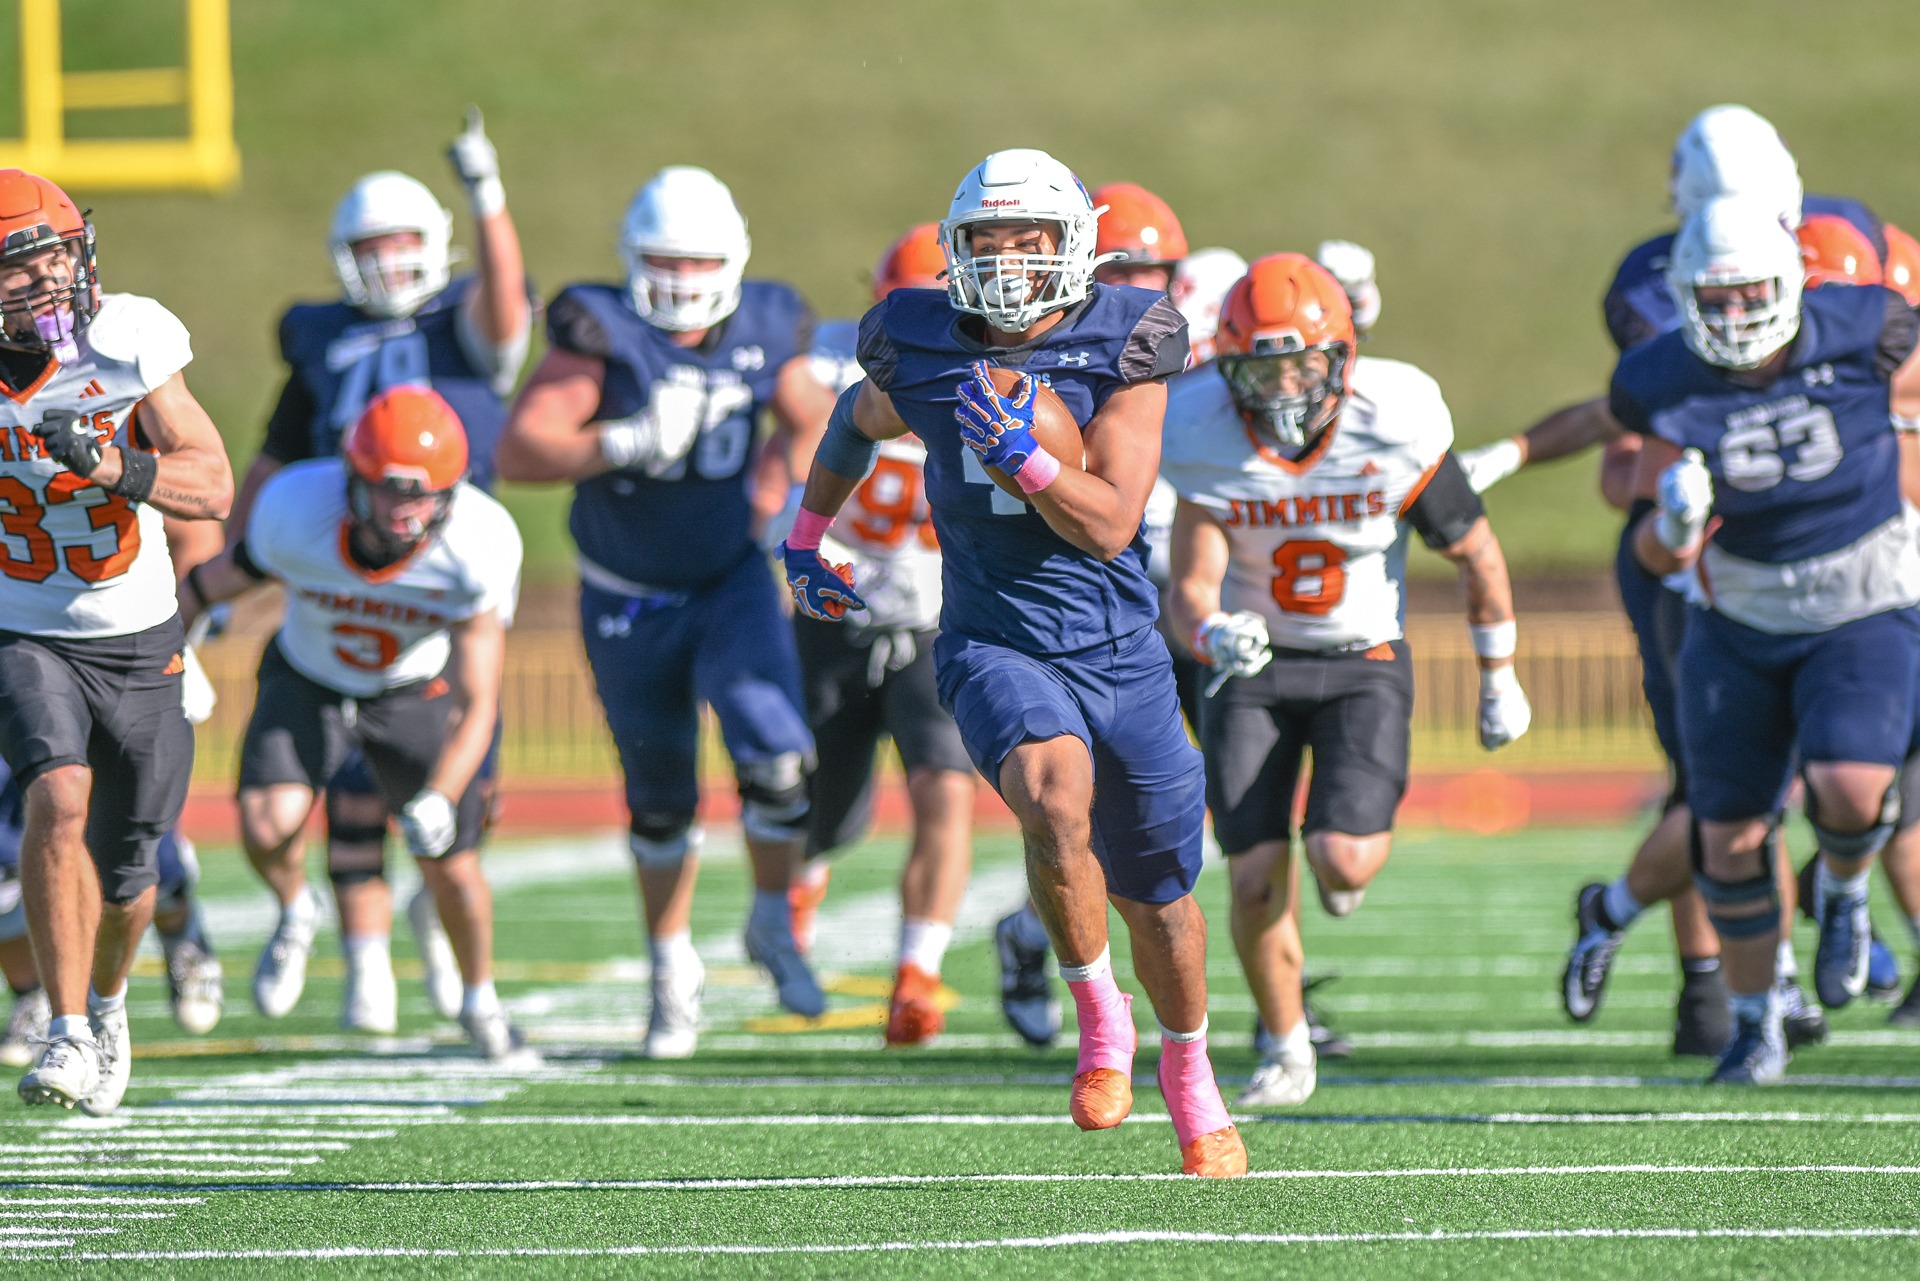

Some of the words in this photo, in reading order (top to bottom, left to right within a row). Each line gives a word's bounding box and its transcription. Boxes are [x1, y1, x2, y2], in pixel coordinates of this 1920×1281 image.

[981, 199, 1020, 208] Riddell
[1719, 404, 1844, 493] 63
[0, 470, 142, 585] 33
[1226, 491, 1386, 527] JIMMIES
[1272, 540, 1348, 616] 8
[333, 621, 400, 674] 3
